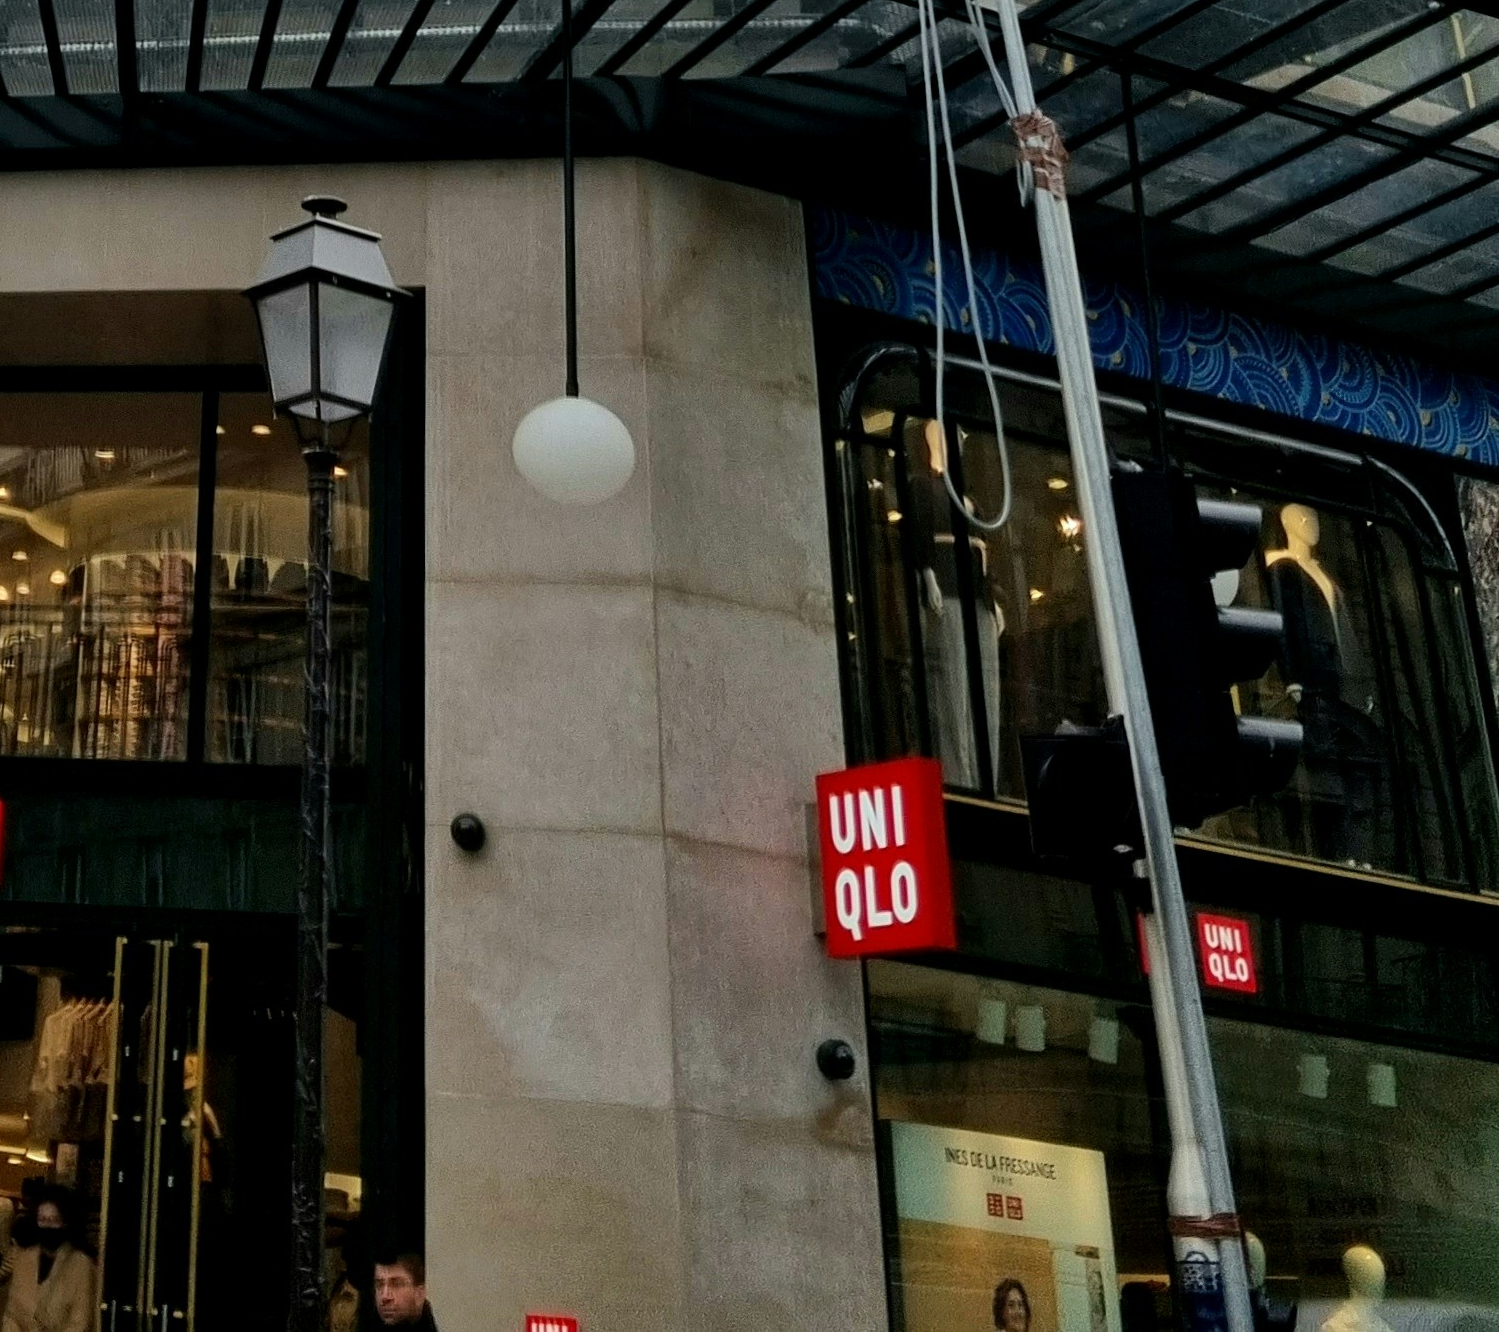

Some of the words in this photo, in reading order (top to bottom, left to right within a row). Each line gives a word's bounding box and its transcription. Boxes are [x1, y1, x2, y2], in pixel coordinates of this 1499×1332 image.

[828, 784, 906, 854] UNI
[835, 861, 918, 941] QLO
[1204, 923, 1241, 953] UNI
[1208, 953, 1248, 982] QLO
[944, 1147, 968, 1166] INES
[970, 1151, 983, 1168] DE
[985, 1154, 997, 1170] LA
[999, 1156, 1056, 1180] FRESSANGE
